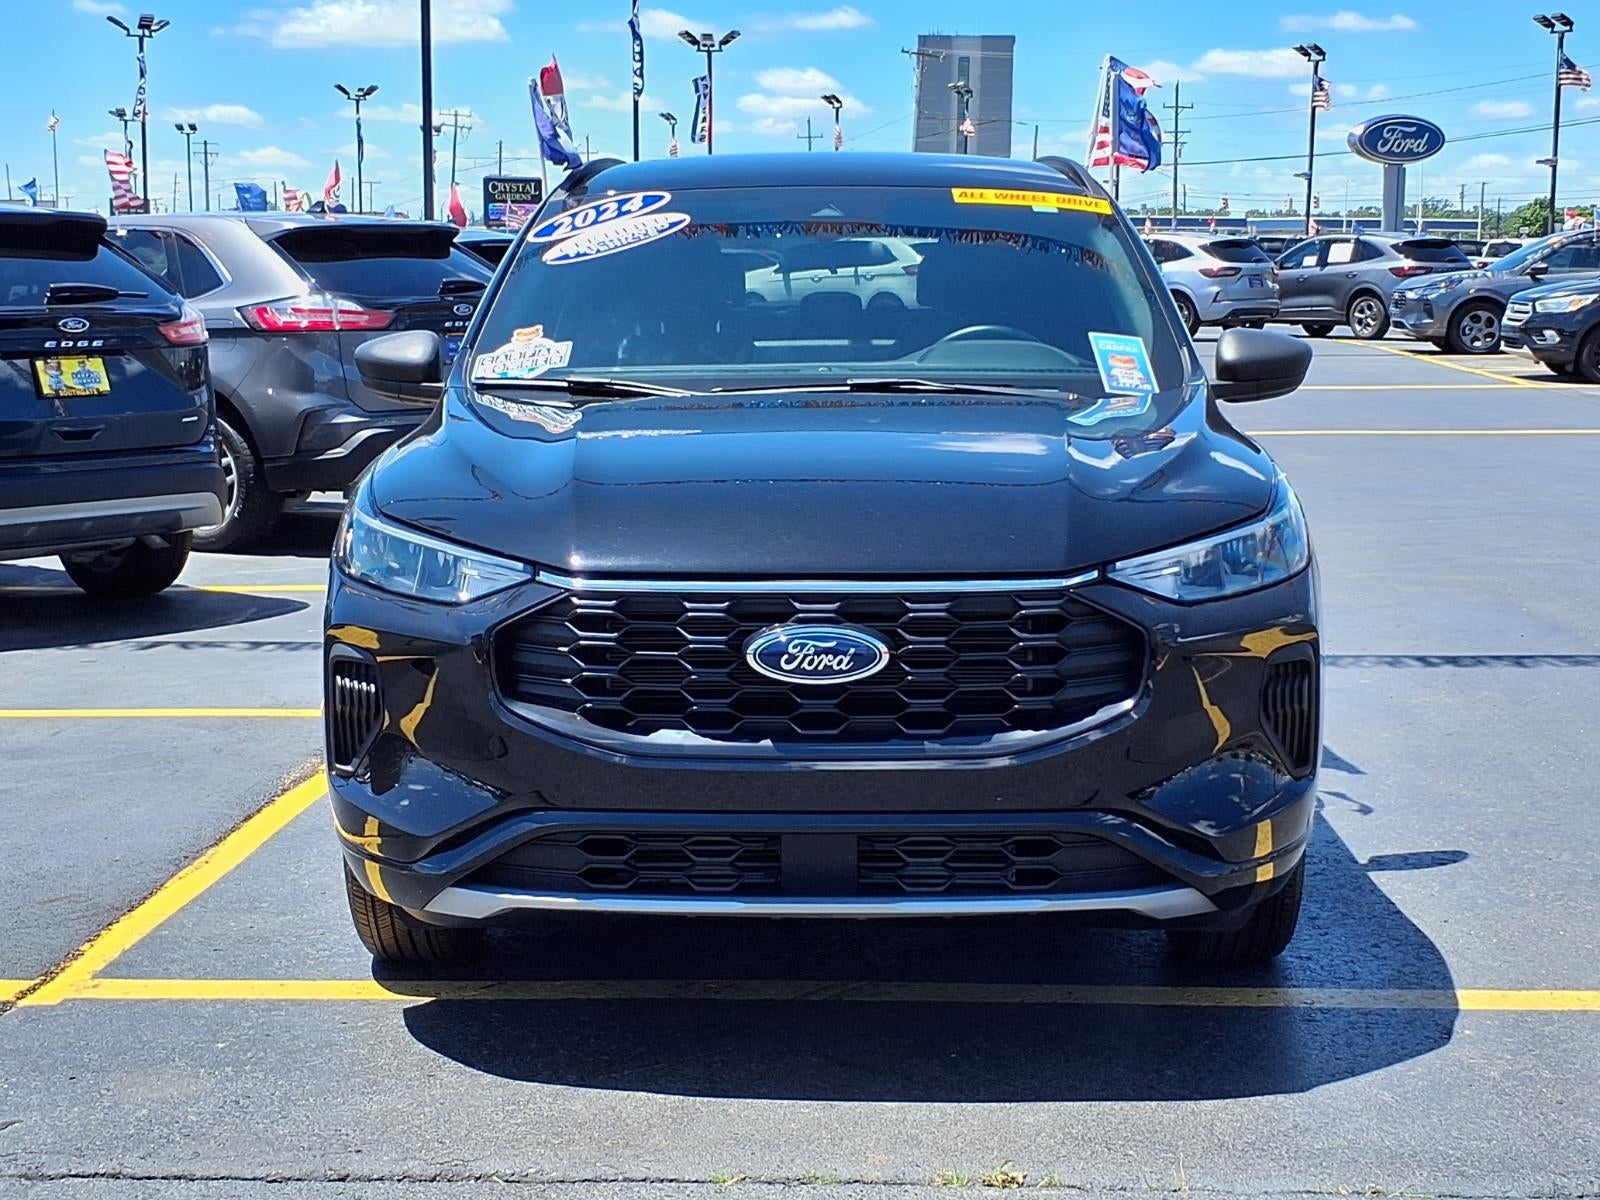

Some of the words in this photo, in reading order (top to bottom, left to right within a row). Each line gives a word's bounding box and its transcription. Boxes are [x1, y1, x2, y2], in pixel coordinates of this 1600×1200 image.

[1377, 125, 1429, 153] Ford
[488, 181, 539, 195] CRYSTAL
[958, 191, 985, 199] ALL
[994, 192, 1049, 203] WHEEL
[1056, 198, 1103, 209] DRIVE
[551, 195, 644, 236] 2024
[44, 340, 104, 348] EDGE
[780, 639, 855, 671] Ford
